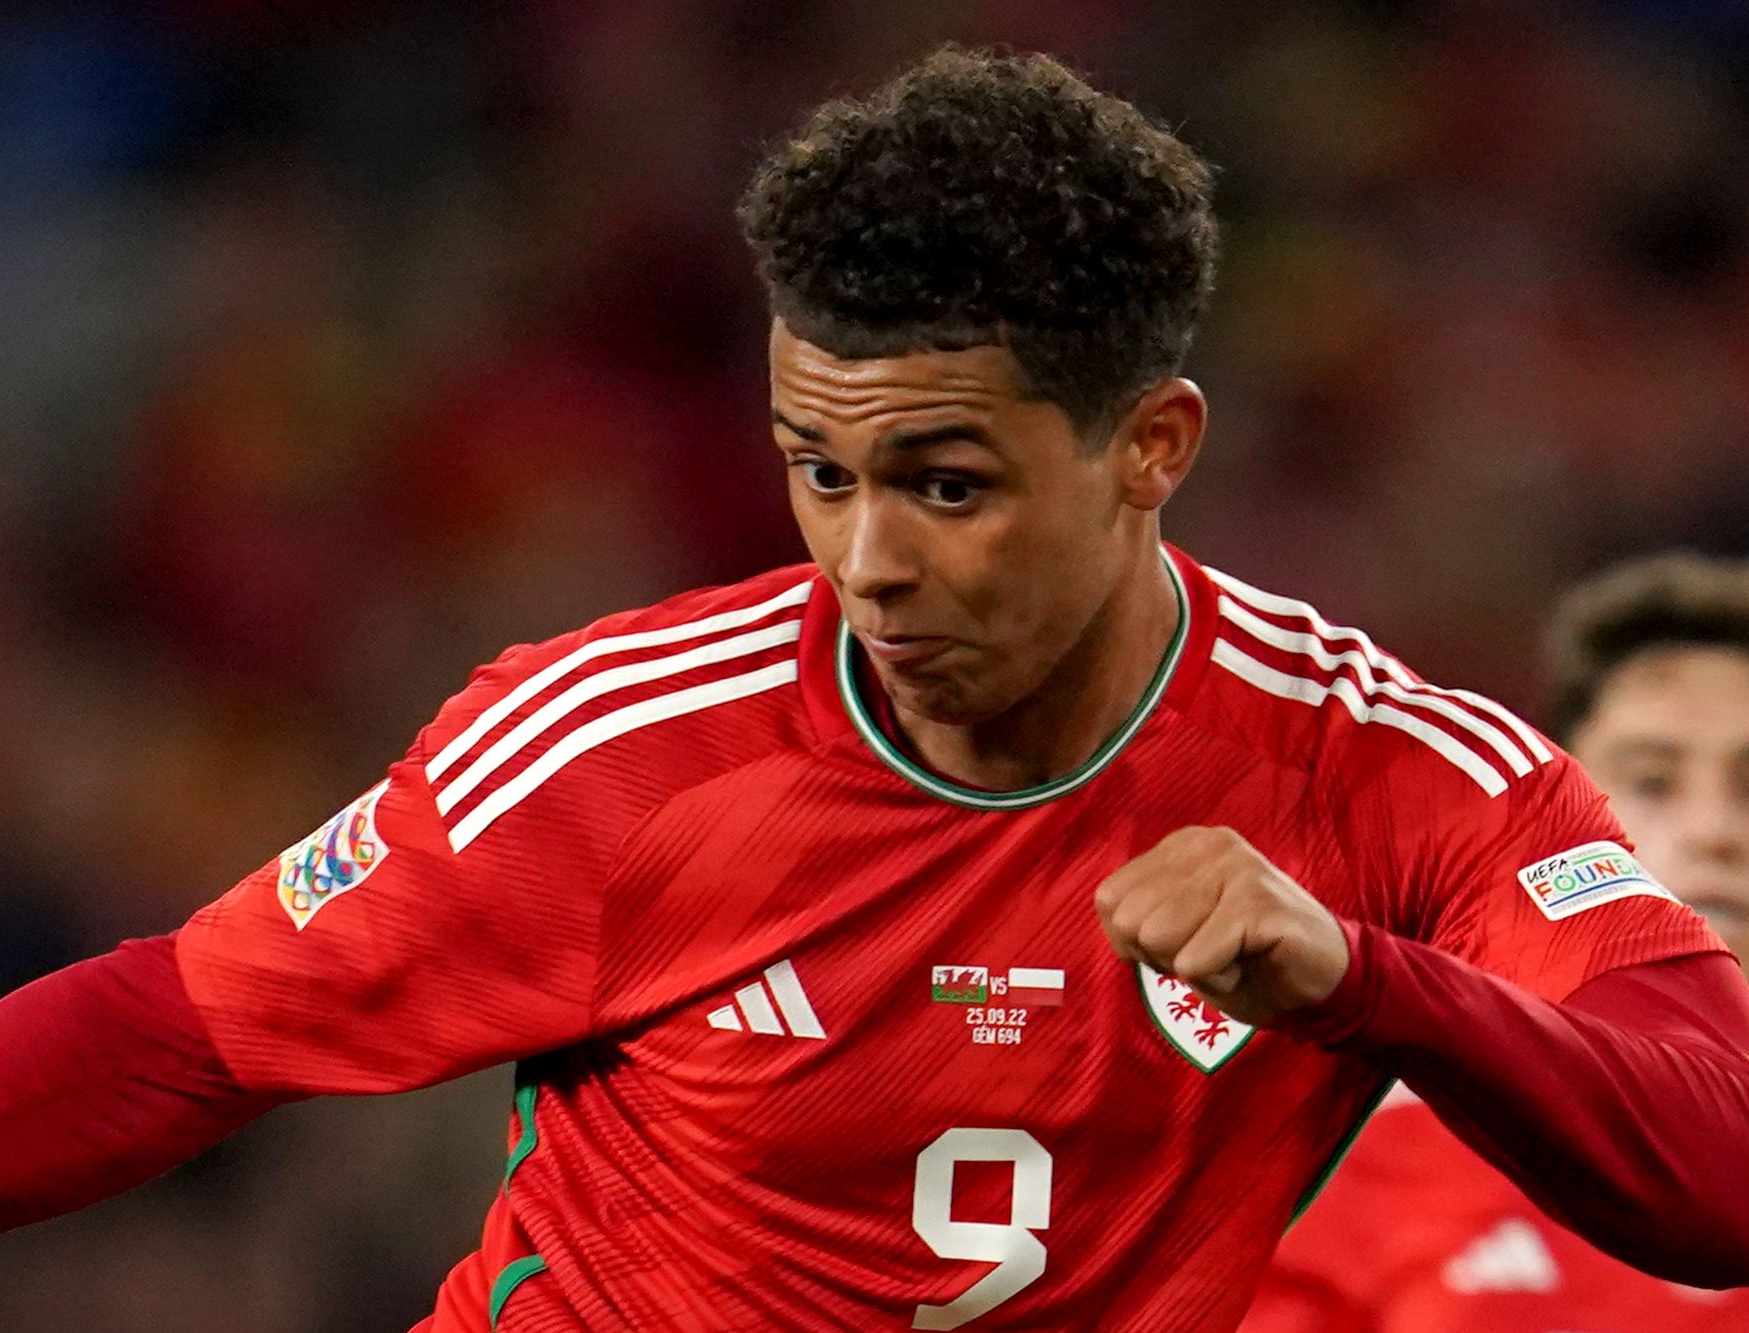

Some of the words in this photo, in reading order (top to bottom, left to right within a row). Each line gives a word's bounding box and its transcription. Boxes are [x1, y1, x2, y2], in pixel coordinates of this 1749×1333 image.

[1526, 858, 1568, 884] UEFA
[1534, 858, 1639, 902] FOUND
[990, 977, 1008, 995] VS
[966, 1008, 1027, 1026] 25.09.22
[998, 1028, 1022, 1044] 694
[911, 1127, 1053, 1332] 9
